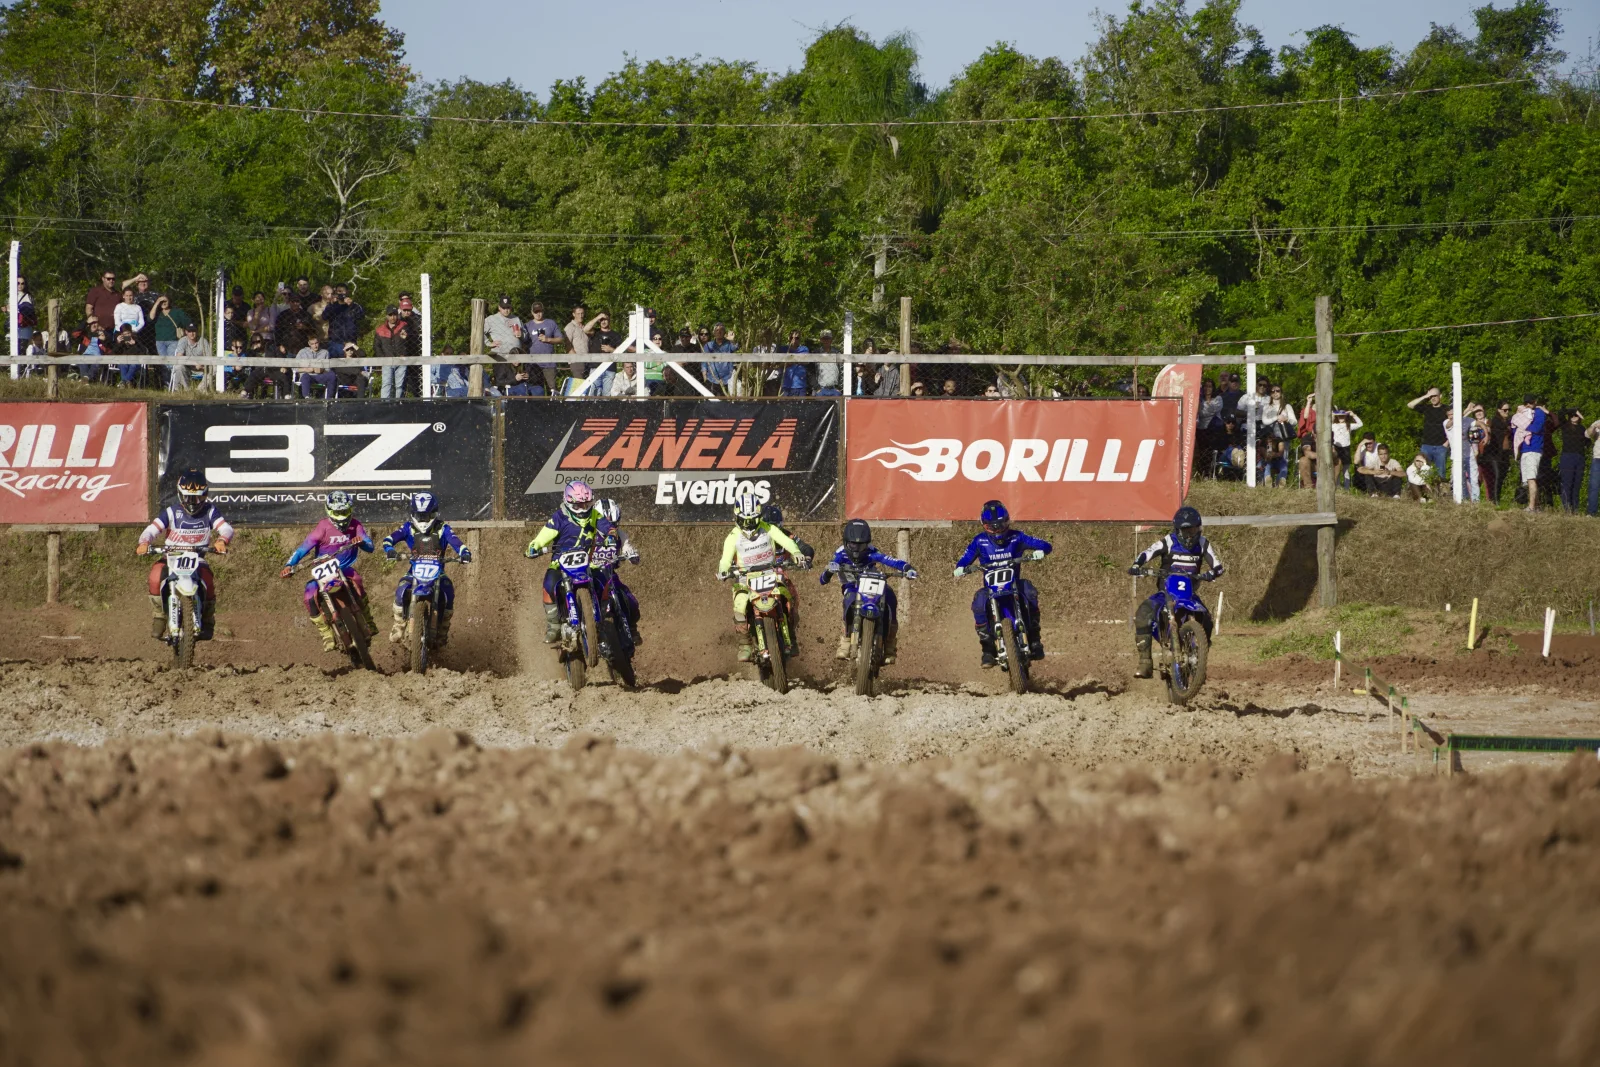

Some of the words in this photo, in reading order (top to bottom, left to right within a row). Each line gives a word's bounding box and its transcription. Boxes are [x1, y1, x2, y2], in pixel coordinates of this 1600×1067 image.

[560, 418, 797, 468] ZANELA
[205, 423, 431, 483] 3Z
[908, 438, 1157, 482] BORILLI
[0, 469, 129, 501] Racing
[600, 474, 629, 485] 1999
[655, 473, 771, 504] Eventos
[176, 556, 197, 568] 101
[562, 553, 587, 566] 43
[989, 552, 1012, 560] YAMAHA
[315, 560, 340, 580] 211
[415, 563, 439, 577] 517
[749, 575, 776, 591] 112
[858, 577, 886, 595] 161
[1177, 581, 1186, 590] 2
